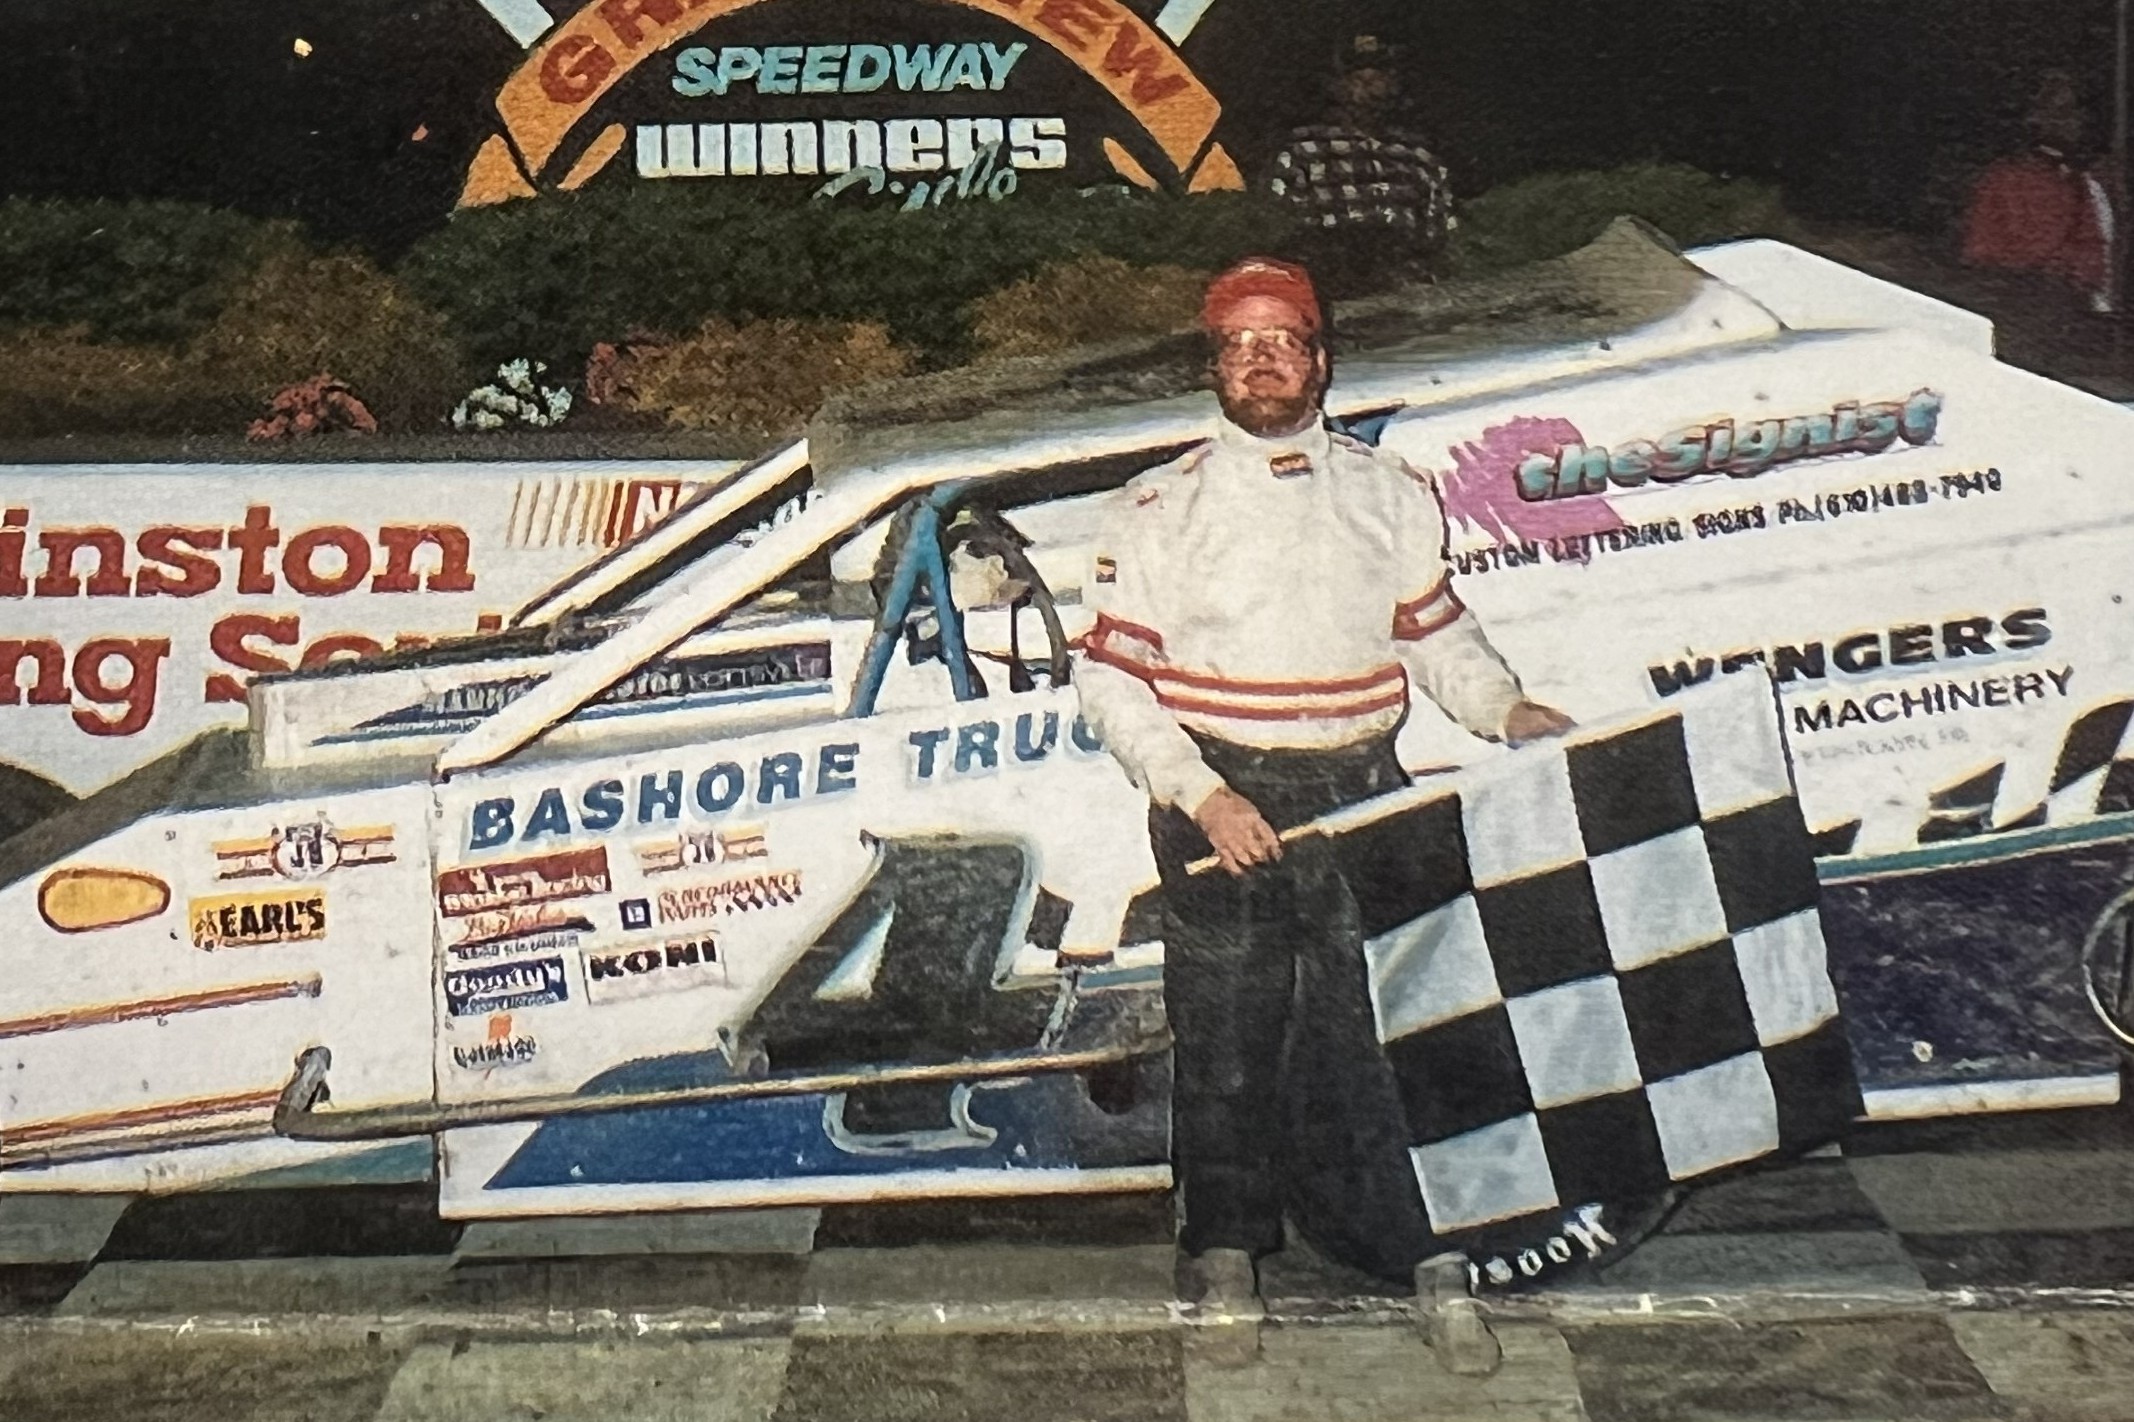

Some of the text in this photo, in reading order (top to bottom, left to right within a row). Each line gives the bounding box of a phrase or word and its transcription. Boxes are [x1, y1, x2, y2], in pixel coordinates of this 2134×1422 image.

[672, 42, 1027, 97] SPEEDWAY
[1793, 664, 2076, 734] MACHINERY
[469, 742, 861, 850] BASHORE
